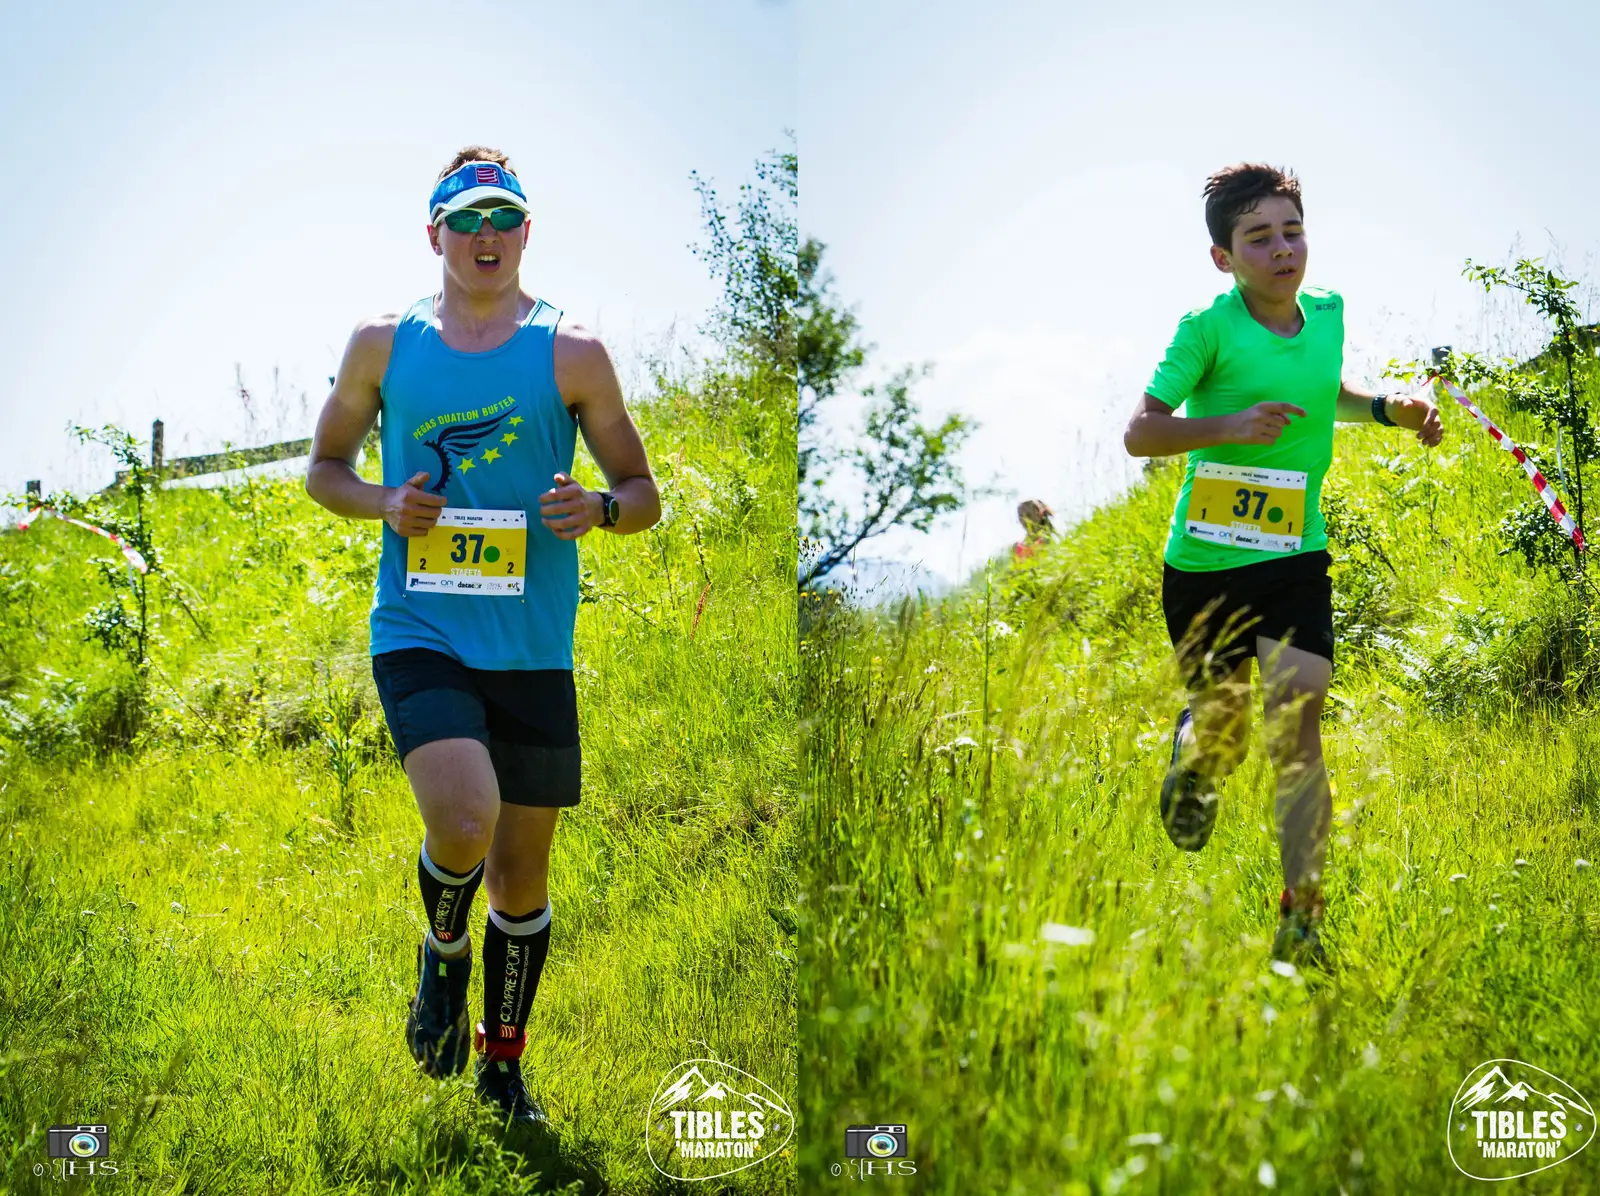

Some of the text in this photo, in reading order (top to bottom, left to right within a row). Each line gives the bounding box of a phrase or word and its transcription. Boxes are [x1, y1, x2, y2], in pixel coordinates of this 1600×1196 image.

[413, 395, 516, 440] PEGAS DUATLON BUFTEA
[1232, 488, 1269, 520] 37
[1201, 508, 1207, 520] 1
[1288, 521, 1293, 533] 1
[450, 533, 485, 564] 37
[419, 558, 427, 570] 2
[507, 562, 514, 574] 2
